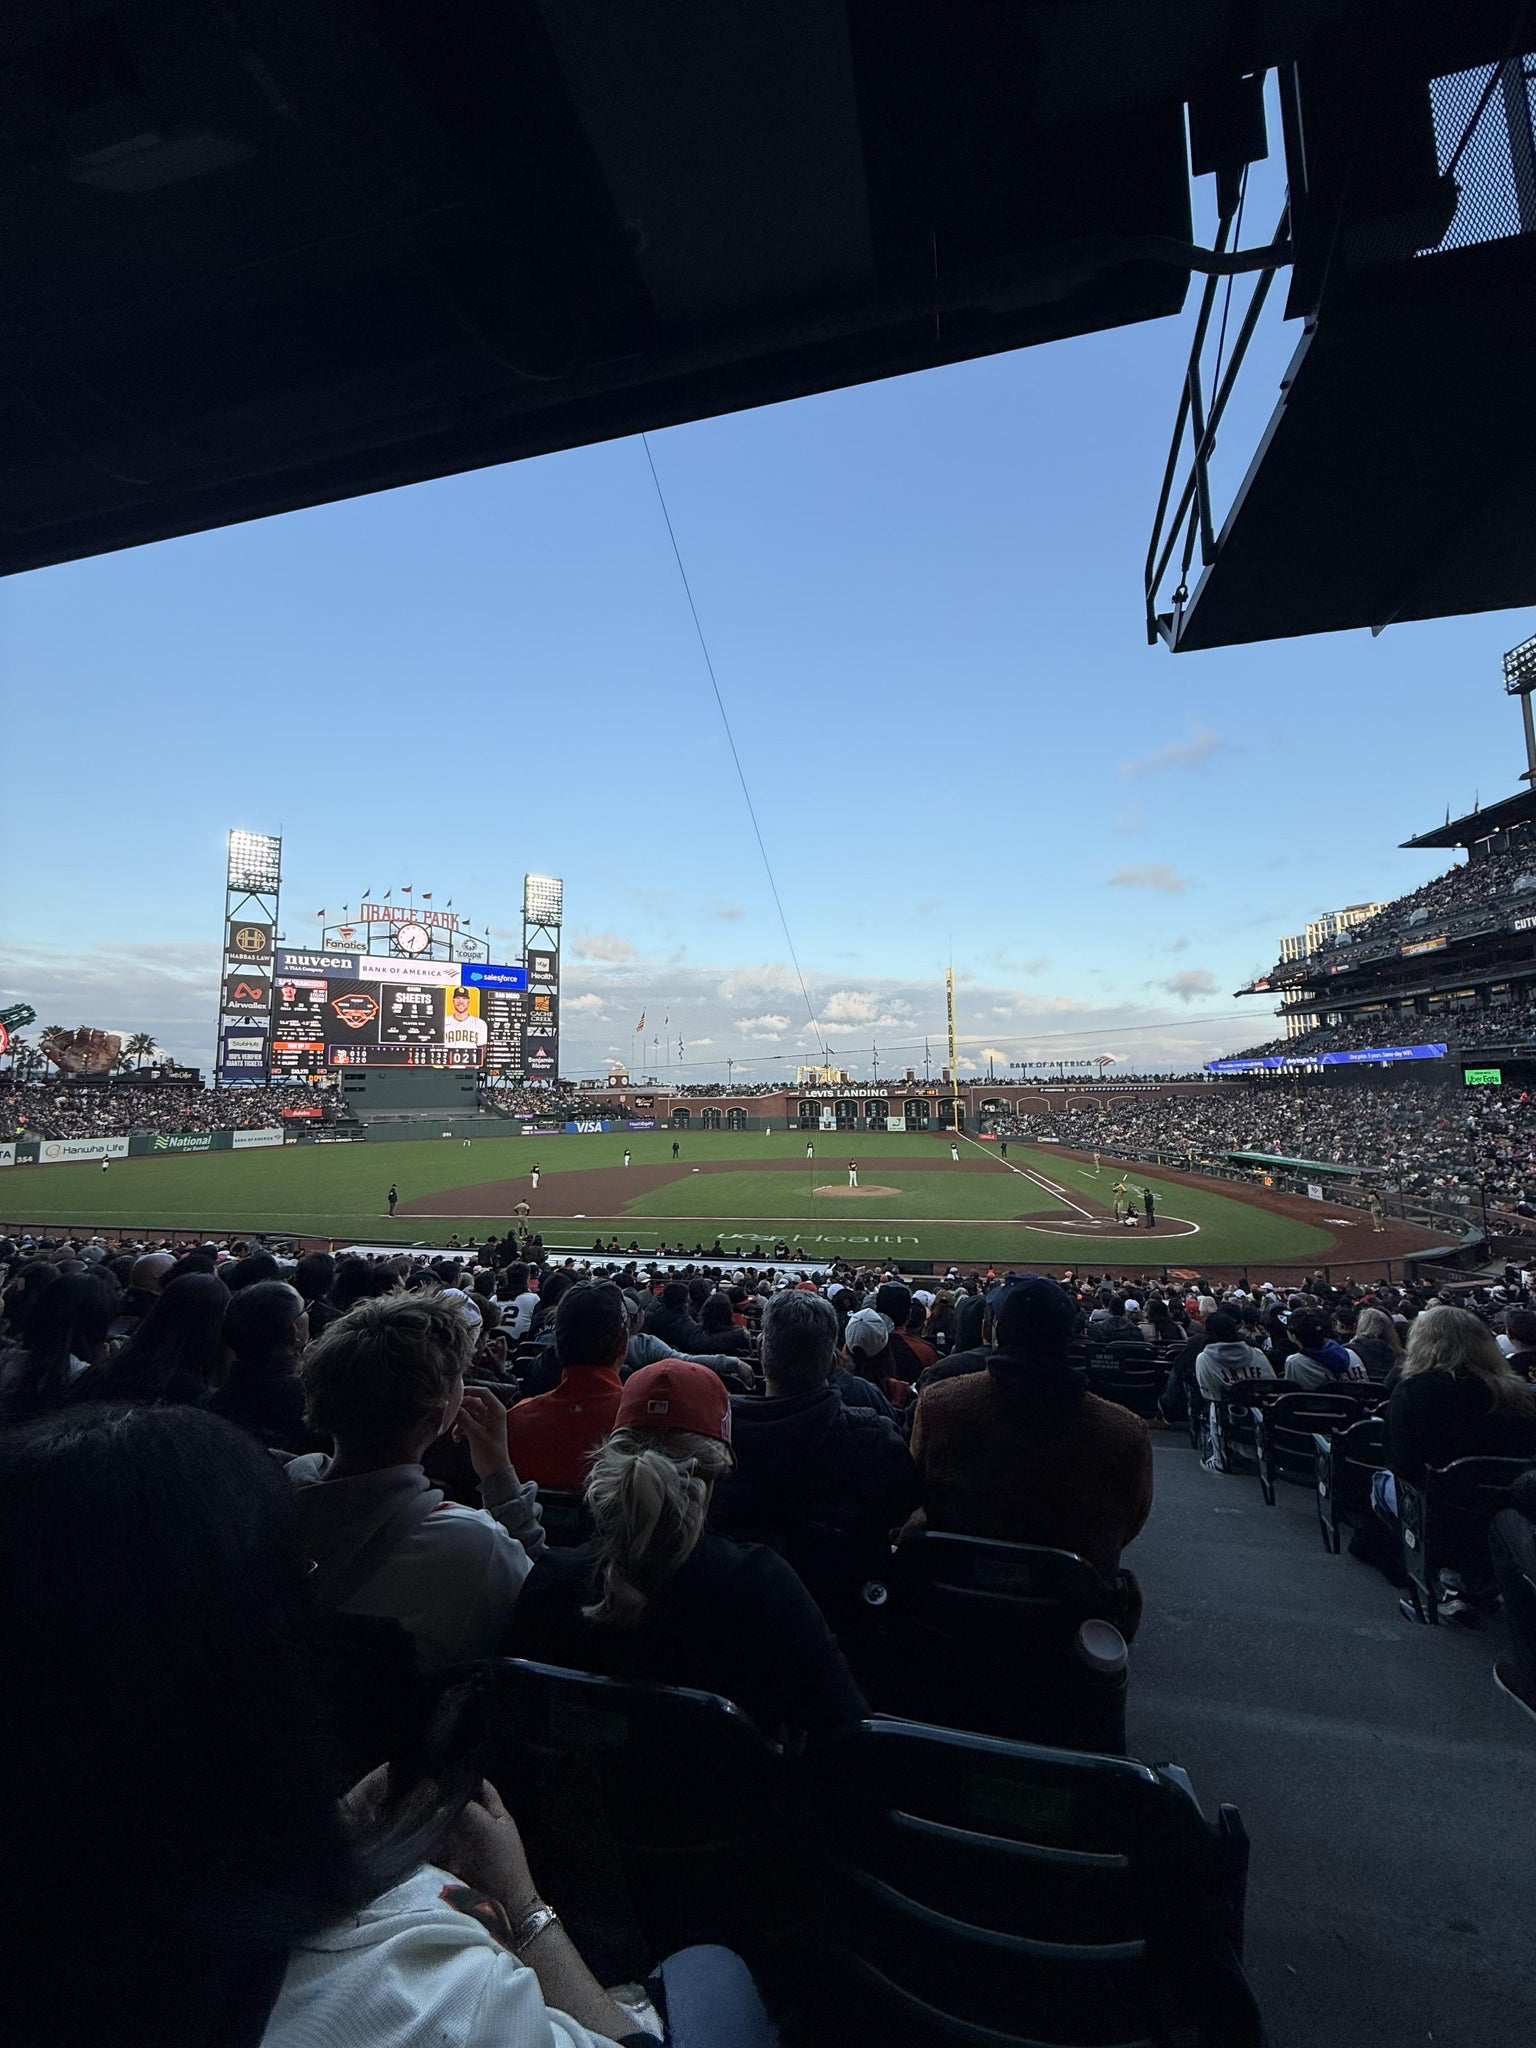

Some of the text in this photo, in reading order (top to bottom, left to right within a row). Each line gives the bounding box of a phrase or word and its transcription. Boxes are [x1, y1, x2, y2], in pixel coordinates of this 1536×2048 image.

[360, 903, 460, 932] ORACLE PARK
[325, 938, 367, 951] Fanatics
[284, 954, 353, 969] nuveen
[362, 965, 388, 973] BANK
[402, 968, 442, 977] AMERICA
[530, 972, 554, 980] Health
[483, 973, 518, 984] salesforce
[395, 992, 432, 1004] SHEETS
[227, 1000, 267, 1010] Airwallex
[528, 1056, 555, 1064] Benjamin
[532, 1061, 551, 1069] Moore
[1049, 1060, 1092, 1068] AMERICA
[1467, 1075, 1499, 1083] Uber Eats
[837, 1089, 888, 1098] LANDING
[572, 1121, 603, 1134] VISA
[169, 1135, 212, 1148] National
[62, 1143, 125, 1155] Hanwha Life
[716, 1233, 920, 1244] UCSF Health
